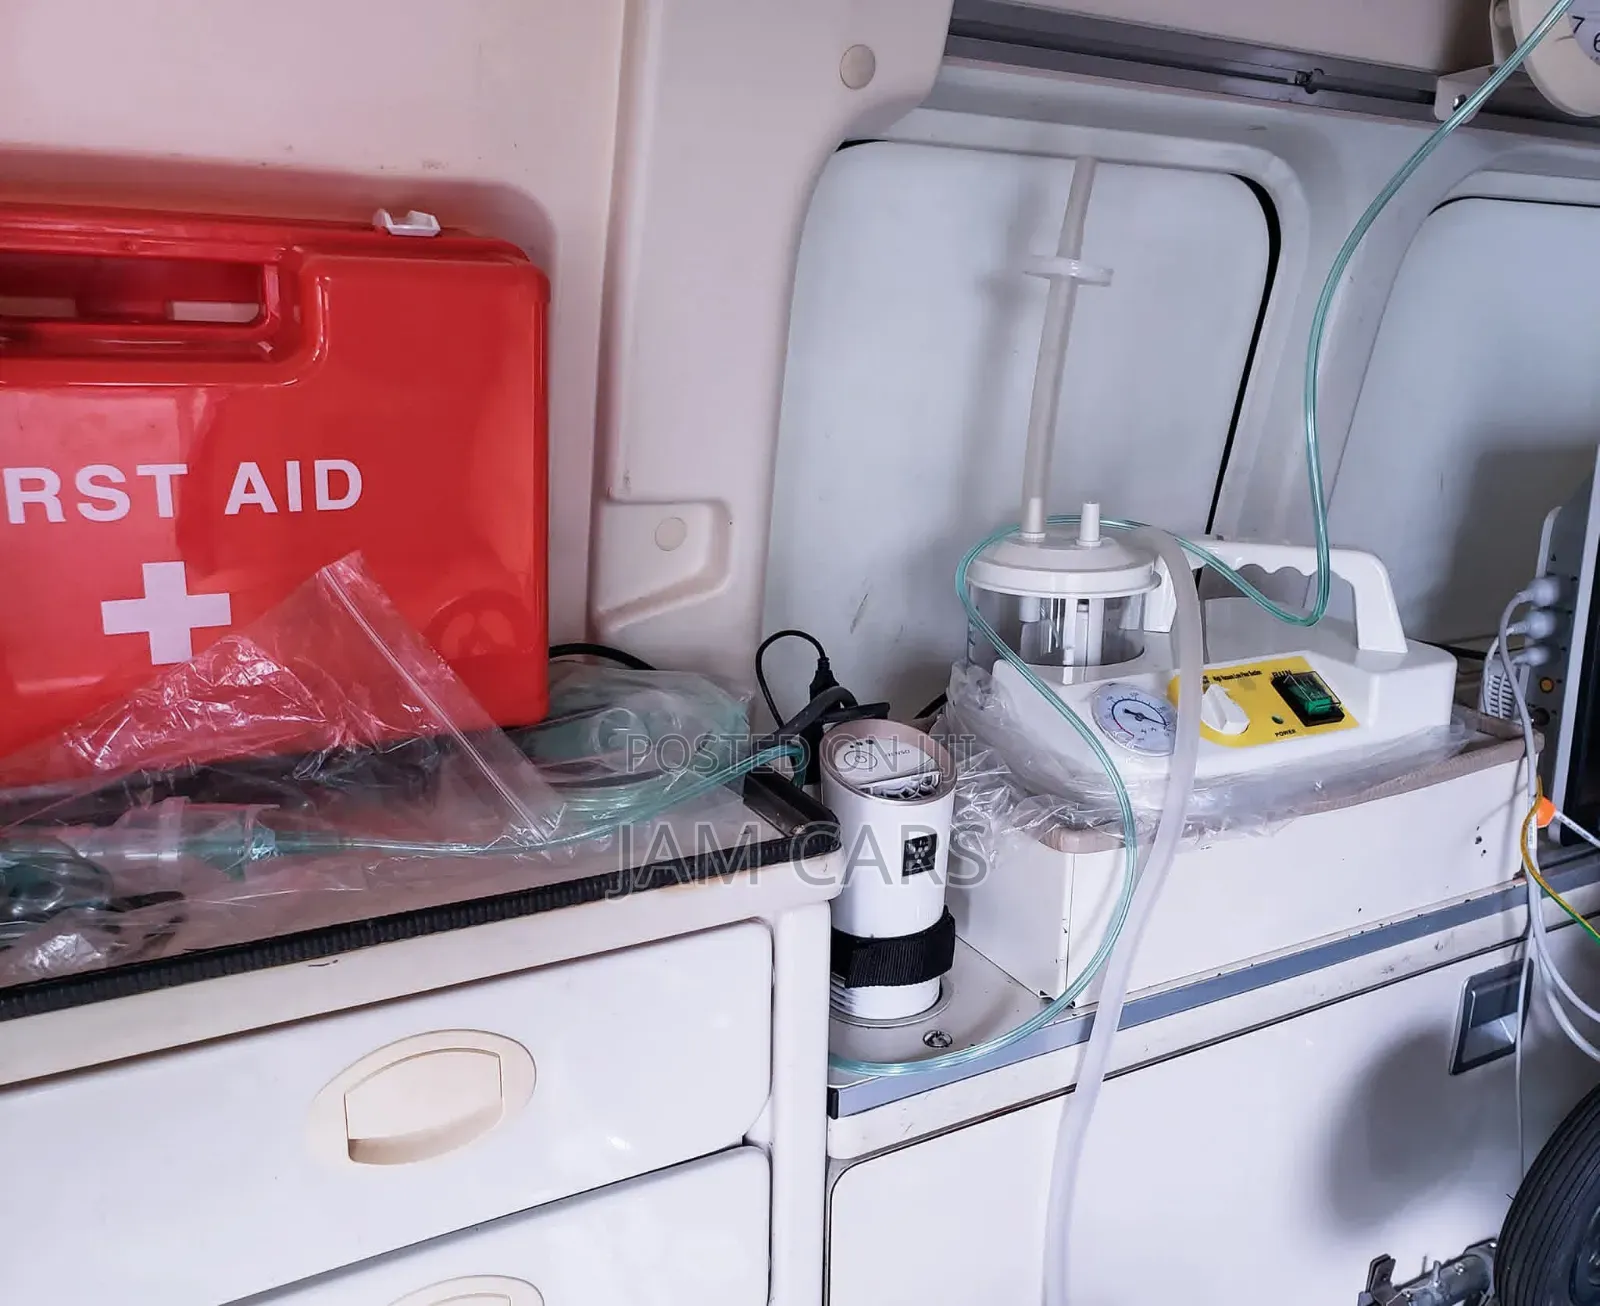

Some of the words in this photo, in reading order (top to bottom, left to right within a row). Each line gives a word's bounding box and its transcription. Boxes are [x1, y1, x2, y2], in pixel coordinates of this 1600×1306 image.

[1572, 15, 1585, 34] 7
[3, 464, 188, 525] RST
[224, 459, 363, 515] AID
[1274, 728, 1296, 737] POWER
